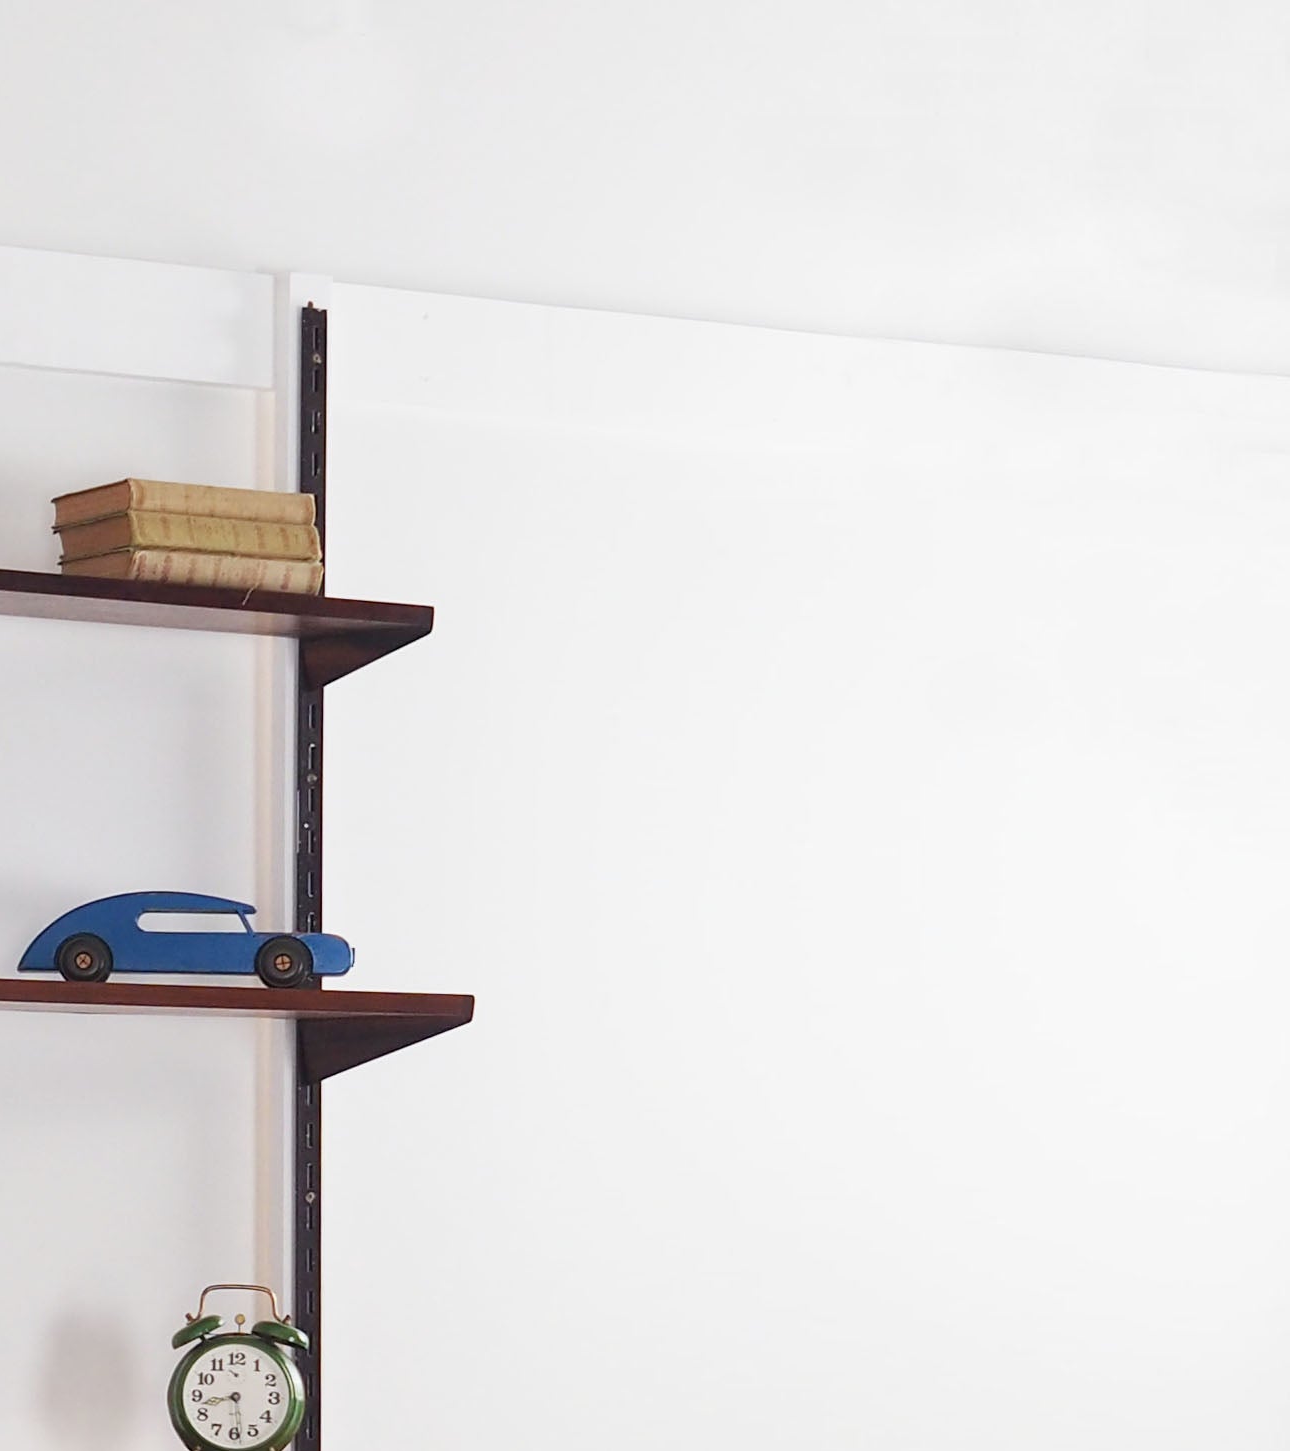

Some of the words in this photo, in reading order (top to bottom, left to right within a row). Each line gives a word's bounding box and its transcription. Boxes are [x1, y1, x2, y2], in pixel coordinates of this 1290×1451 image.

[211, 1358, 224, 1371] 11
[229, 1352, 246, 1365] 12
[253, 1359, 260, 1371] 1
[198, 1372, 214, 1385] 10
[265, 1374, 276, 1387] 2
[192, 1389, 203, 1402] 9
[268, 1392, 280, 1405] 3
[197, 1408, 208, 1421] 8
[259, 1410, 272, 1423] 4
[211, 1424, 222, 1436] 7
[229, 1427, 240, 1440] 6
[247, 1425, 259, 1437] 5
